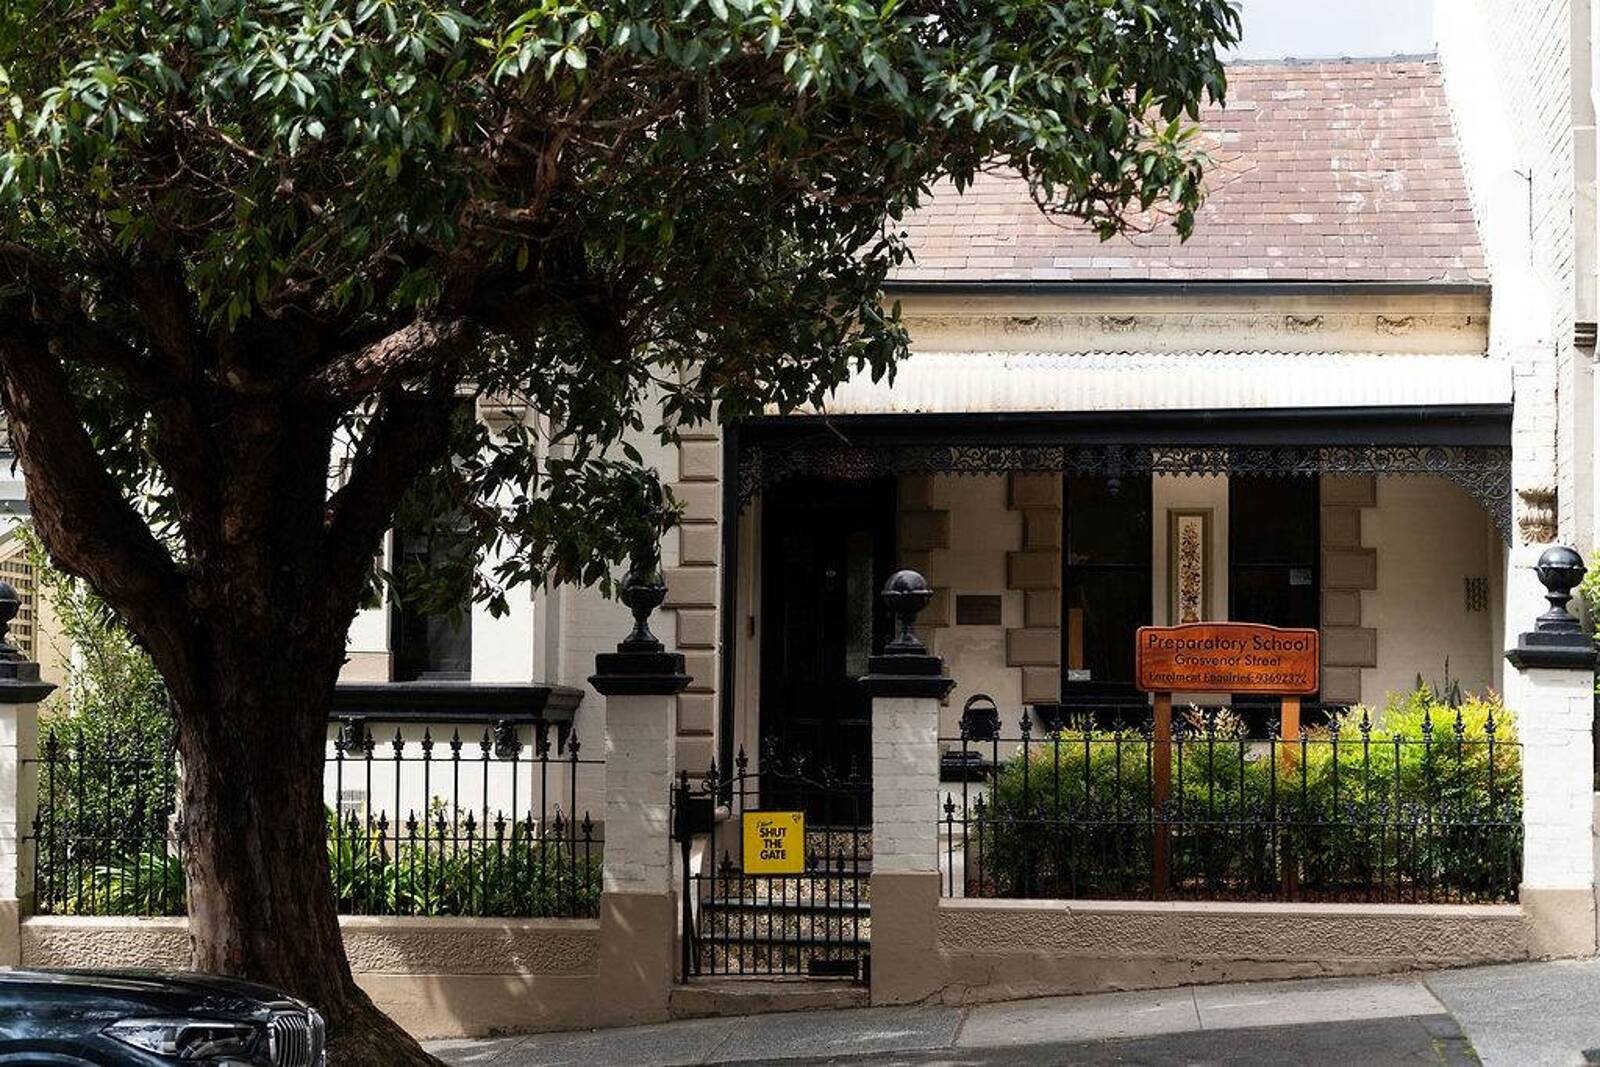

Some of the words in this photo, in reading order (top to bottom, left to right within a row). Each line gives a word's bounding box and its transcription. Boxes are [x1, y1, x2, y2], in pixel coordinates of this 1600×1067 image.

[1149, 634, 1247, 651] Preparatory
[1253, 635, 1309, 651] School
[1175, 655, 1240, 666] Grosvenor
[1245, 655, 1281, 667] Street
[759, 827, 787, 837] SHUT
[763, 838, 783, 848] THE
[760, 849, 787, 859] GATE
